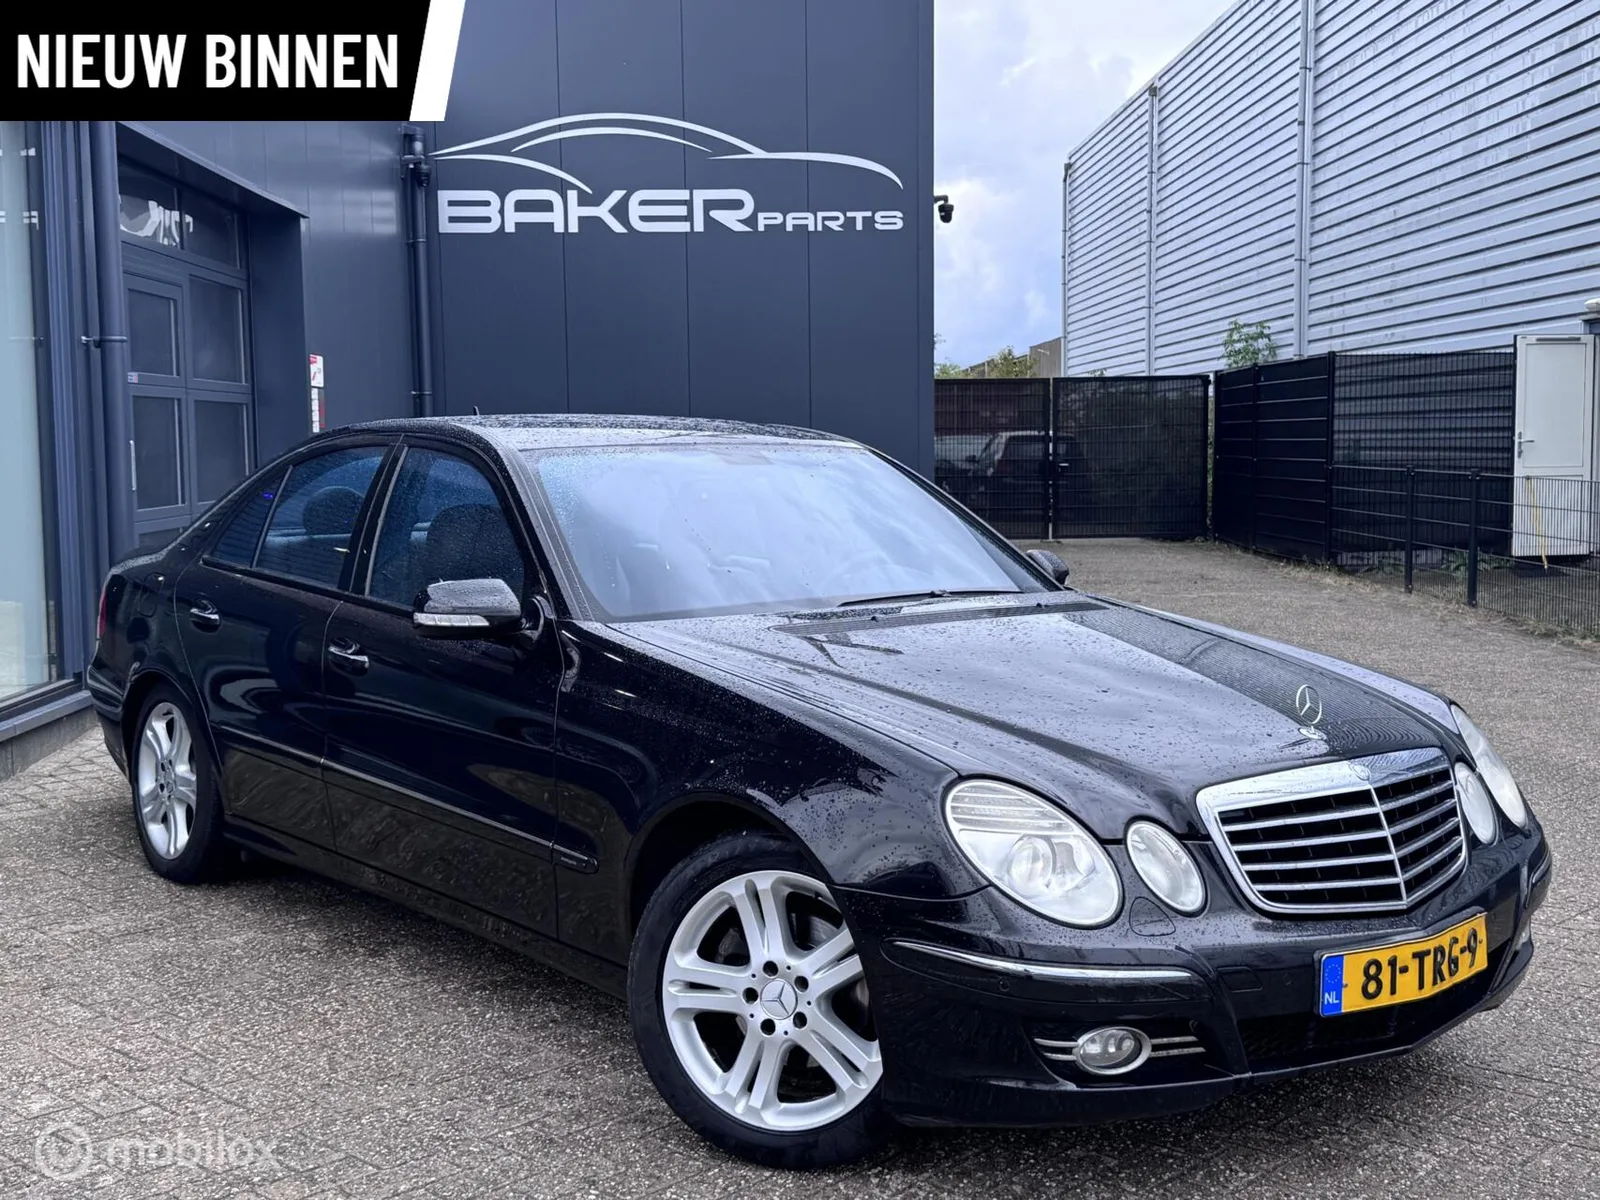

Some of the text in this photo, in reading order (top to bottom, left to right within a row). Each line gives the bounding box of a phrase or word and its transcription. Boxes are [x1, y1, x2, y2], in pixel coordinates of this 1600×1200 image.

[437, 188, 904, 234] BAKER PARTS
[1361, 927, 1478, 1000] 81-TRG-9
[1324, 991, 1340, 1005] NL
